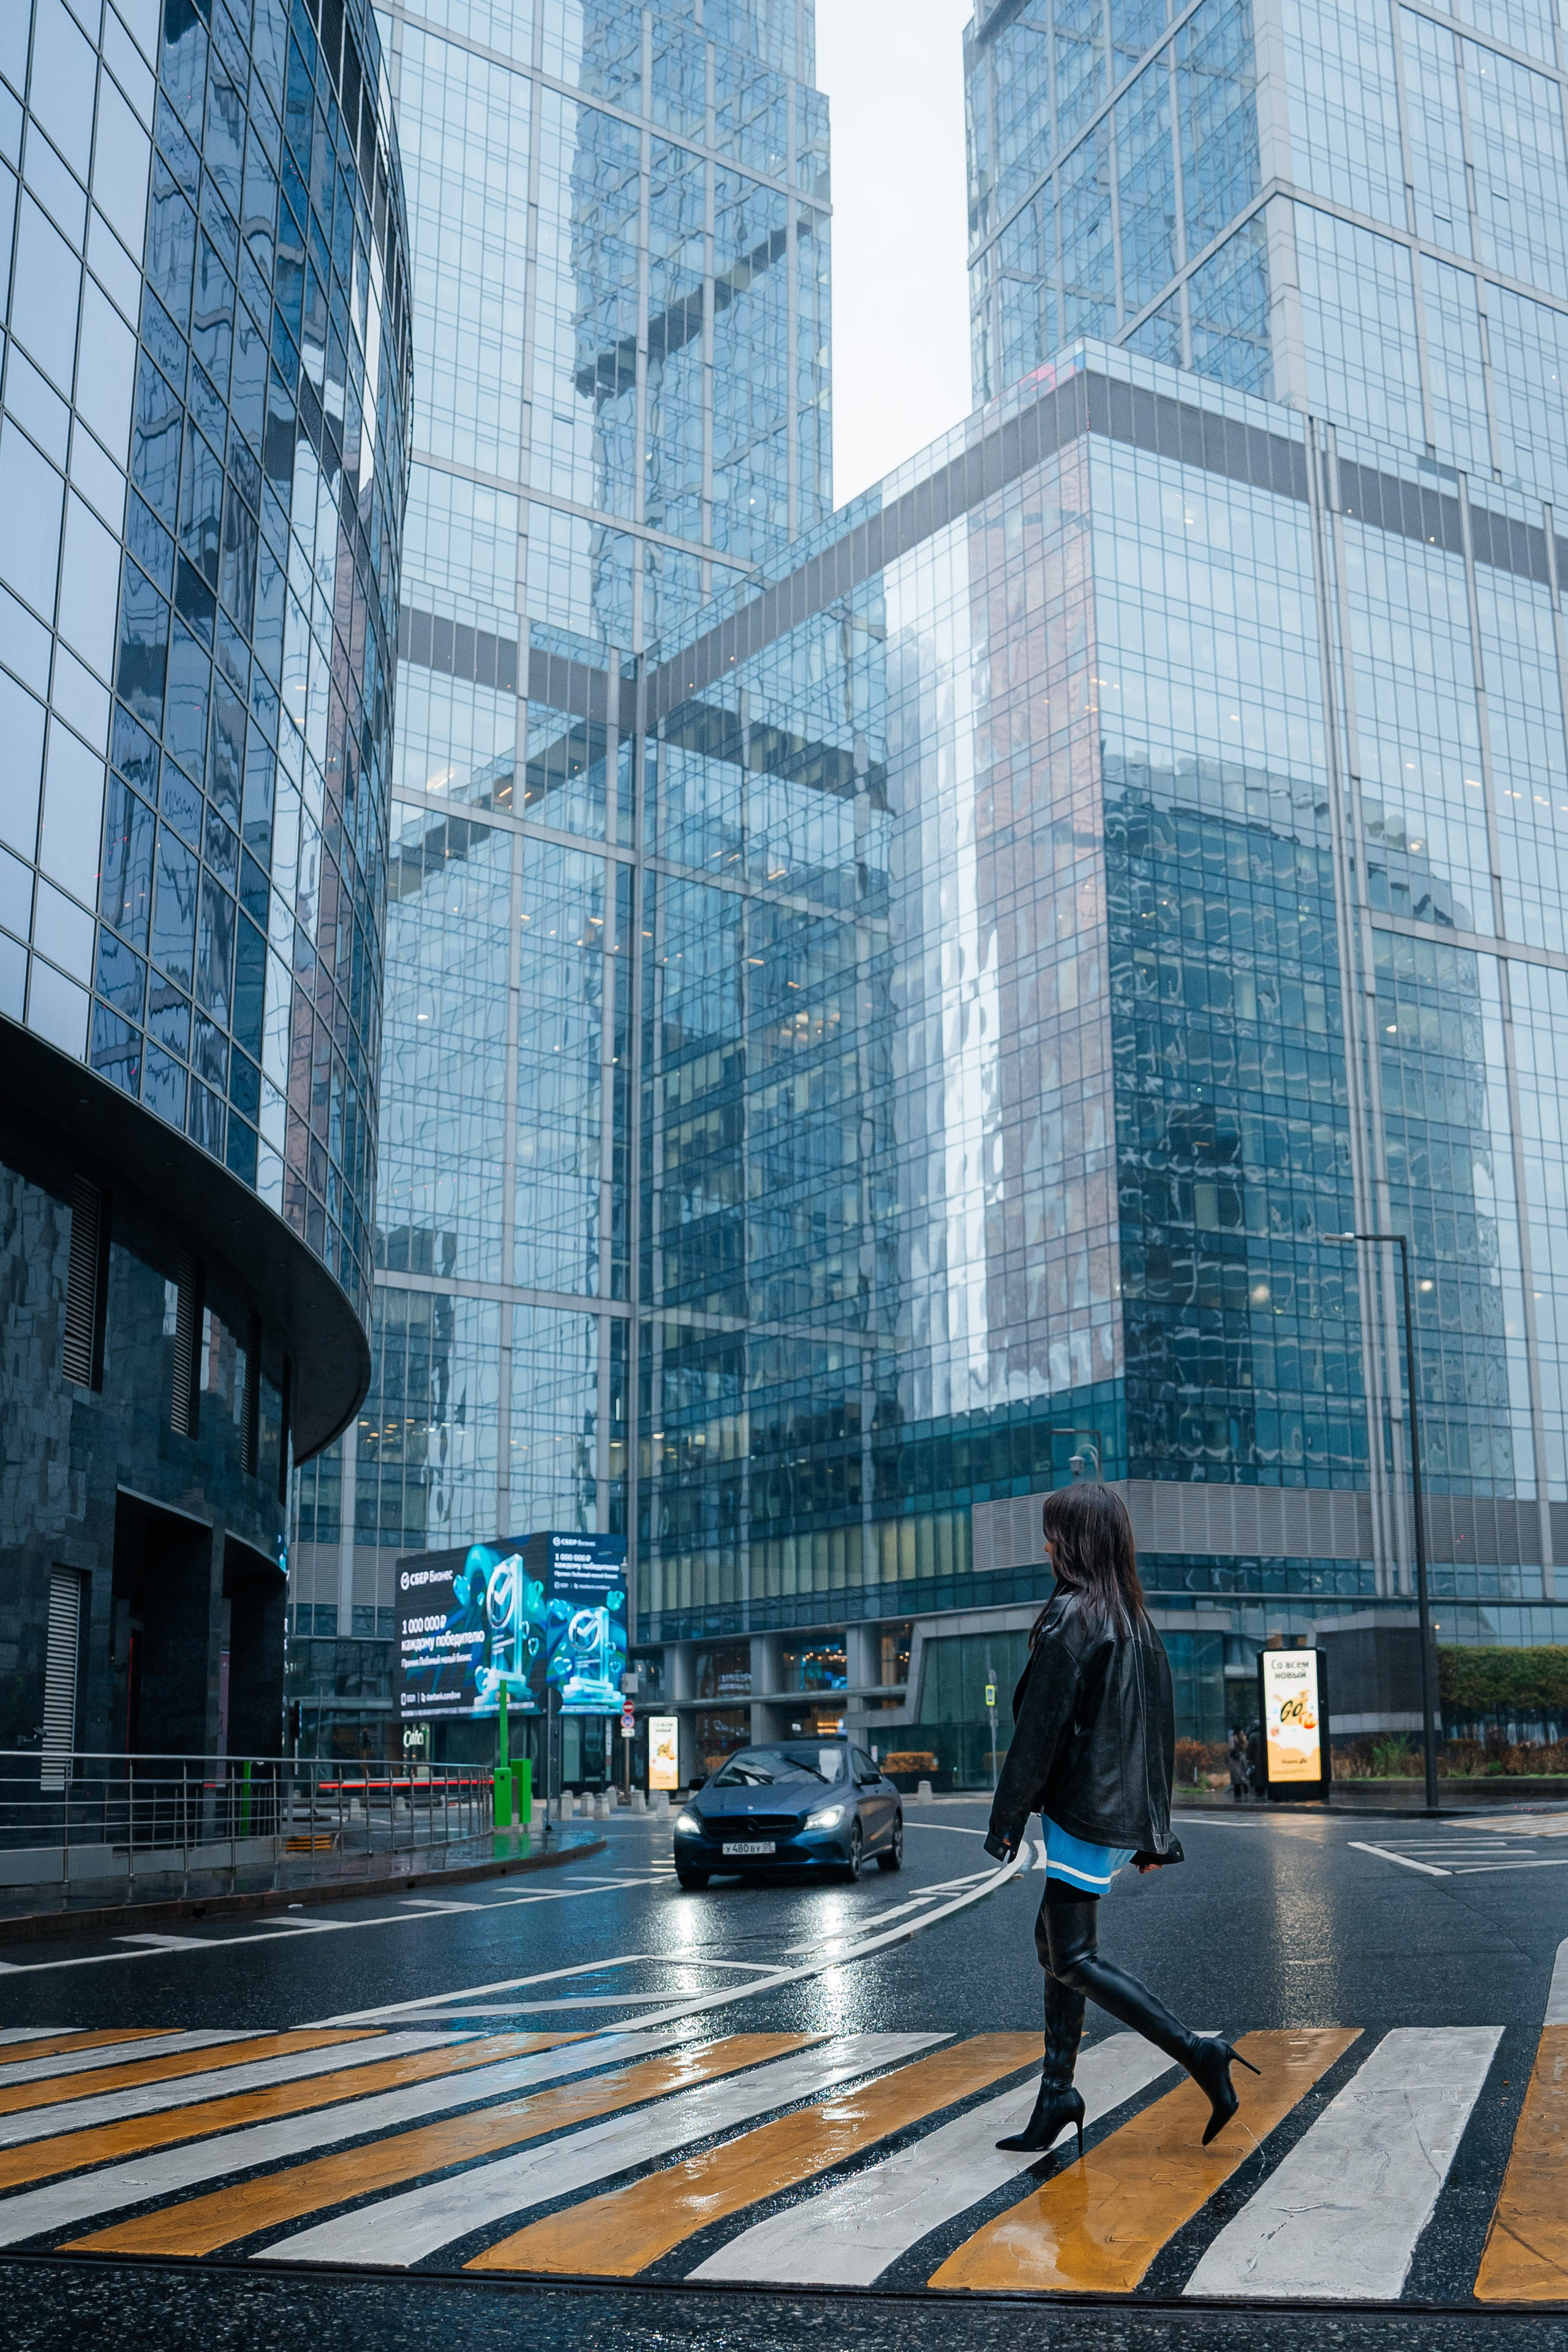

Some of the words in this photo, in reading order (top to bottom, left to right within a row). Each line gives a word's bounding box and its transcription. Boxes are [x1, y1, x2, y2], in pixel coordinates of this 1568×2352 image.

[410, 1571, 429, 1586] СБЕР
[402, 1619, 407, 1634] 1
[408, 1618, 424, 1634] 000
[401, 1637, 435, 1652] каждому
[435, 1630, 485, 1648] победителю
